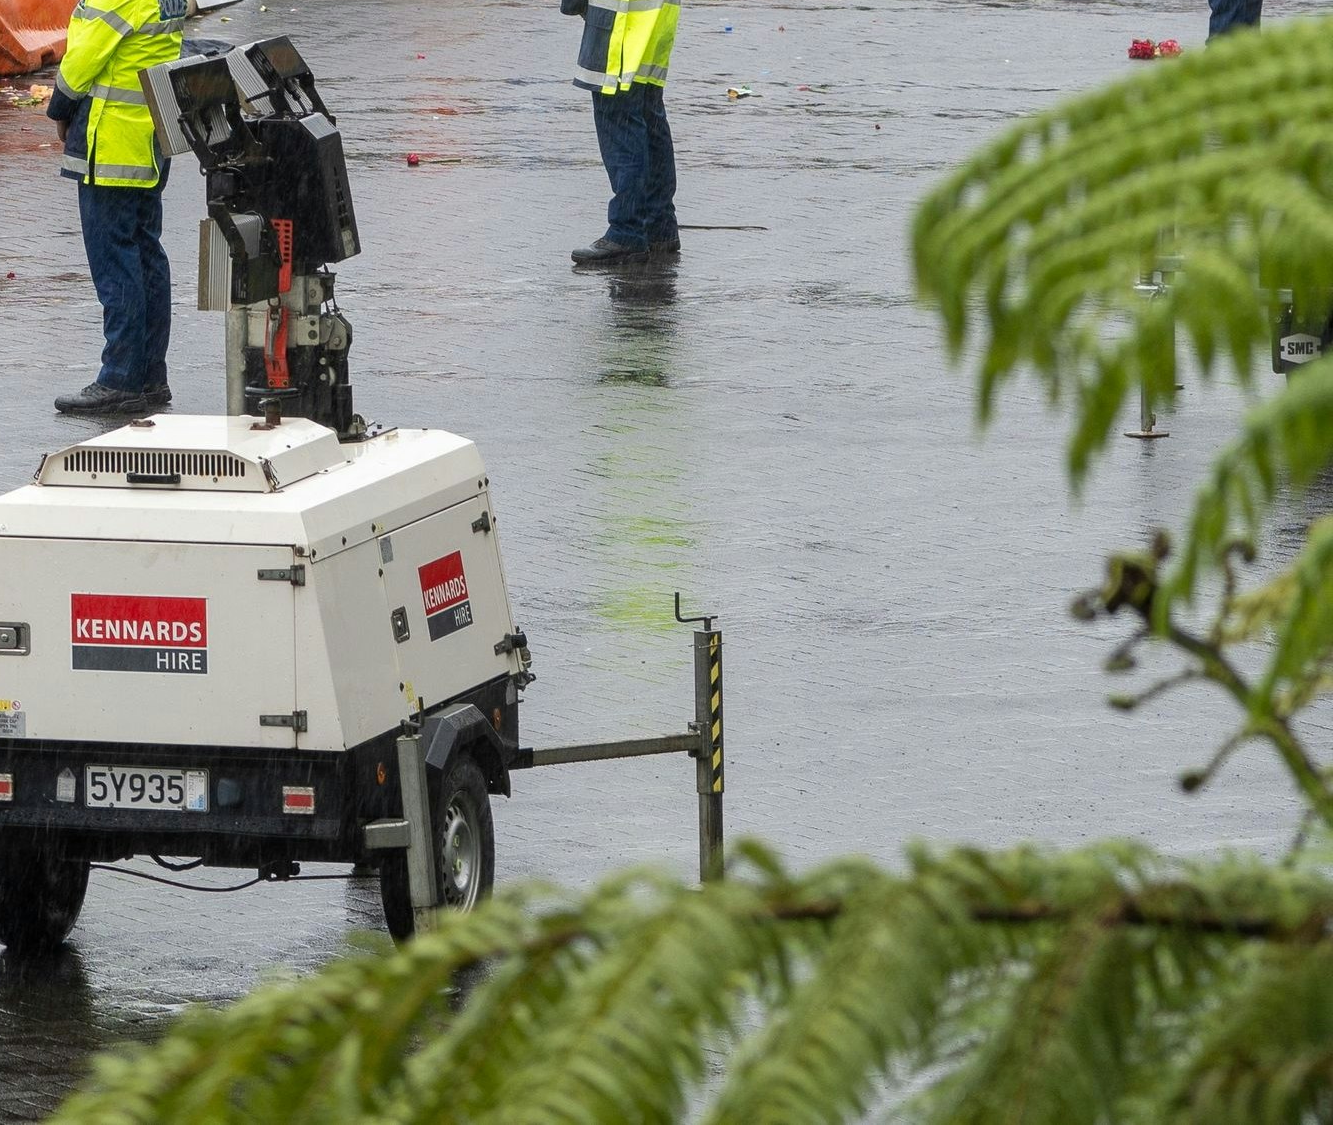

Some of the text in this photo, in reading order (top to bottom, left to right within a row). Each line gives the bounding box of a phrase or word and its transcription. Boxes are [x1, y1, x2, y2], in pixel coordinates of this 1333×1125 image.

[424, 575, 466, 610] KENNARDS
[454, 605, 471, 626] HIRE
[76, 618, 202, 642] KENNARDS
[156, 652, 201, 670] HIRE
[91, 771, 184, 805] 5Y935
